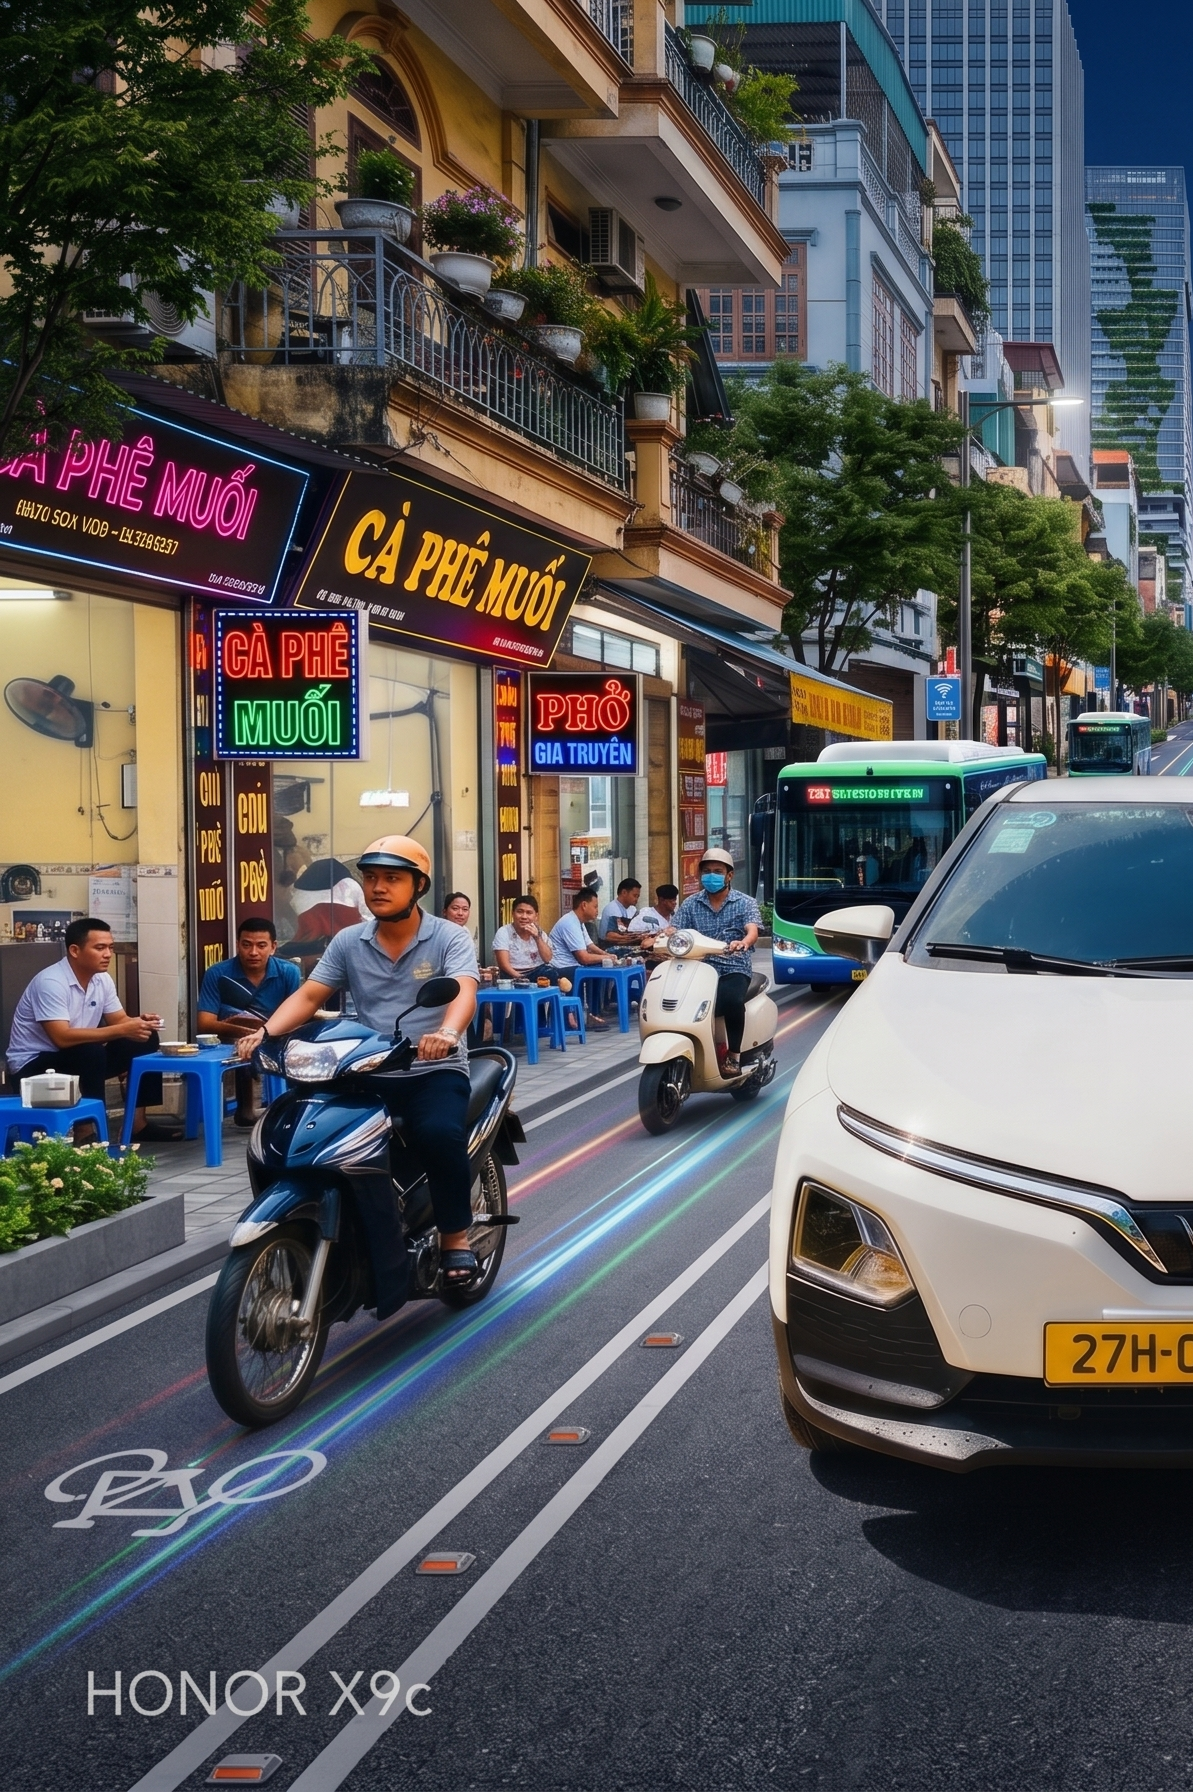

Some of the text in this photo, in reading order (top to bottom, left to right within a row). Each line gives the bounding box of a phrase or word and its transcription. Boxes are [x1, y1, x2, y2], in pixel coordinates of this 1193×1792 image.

[56, 429, 154, 511] PHÊ
[153, 464, 258, 540] MUỐI
[403, 530, 491, 608] PHÊ
[475, 554, 566, 632] MUỐI
[224, 622, 349, 679] CÀ PHÊ
[234, 684, 341, 746] MUỐI
[536, 679, 631, 732] PHỞ
[534, 742, 564, 765] GIA
